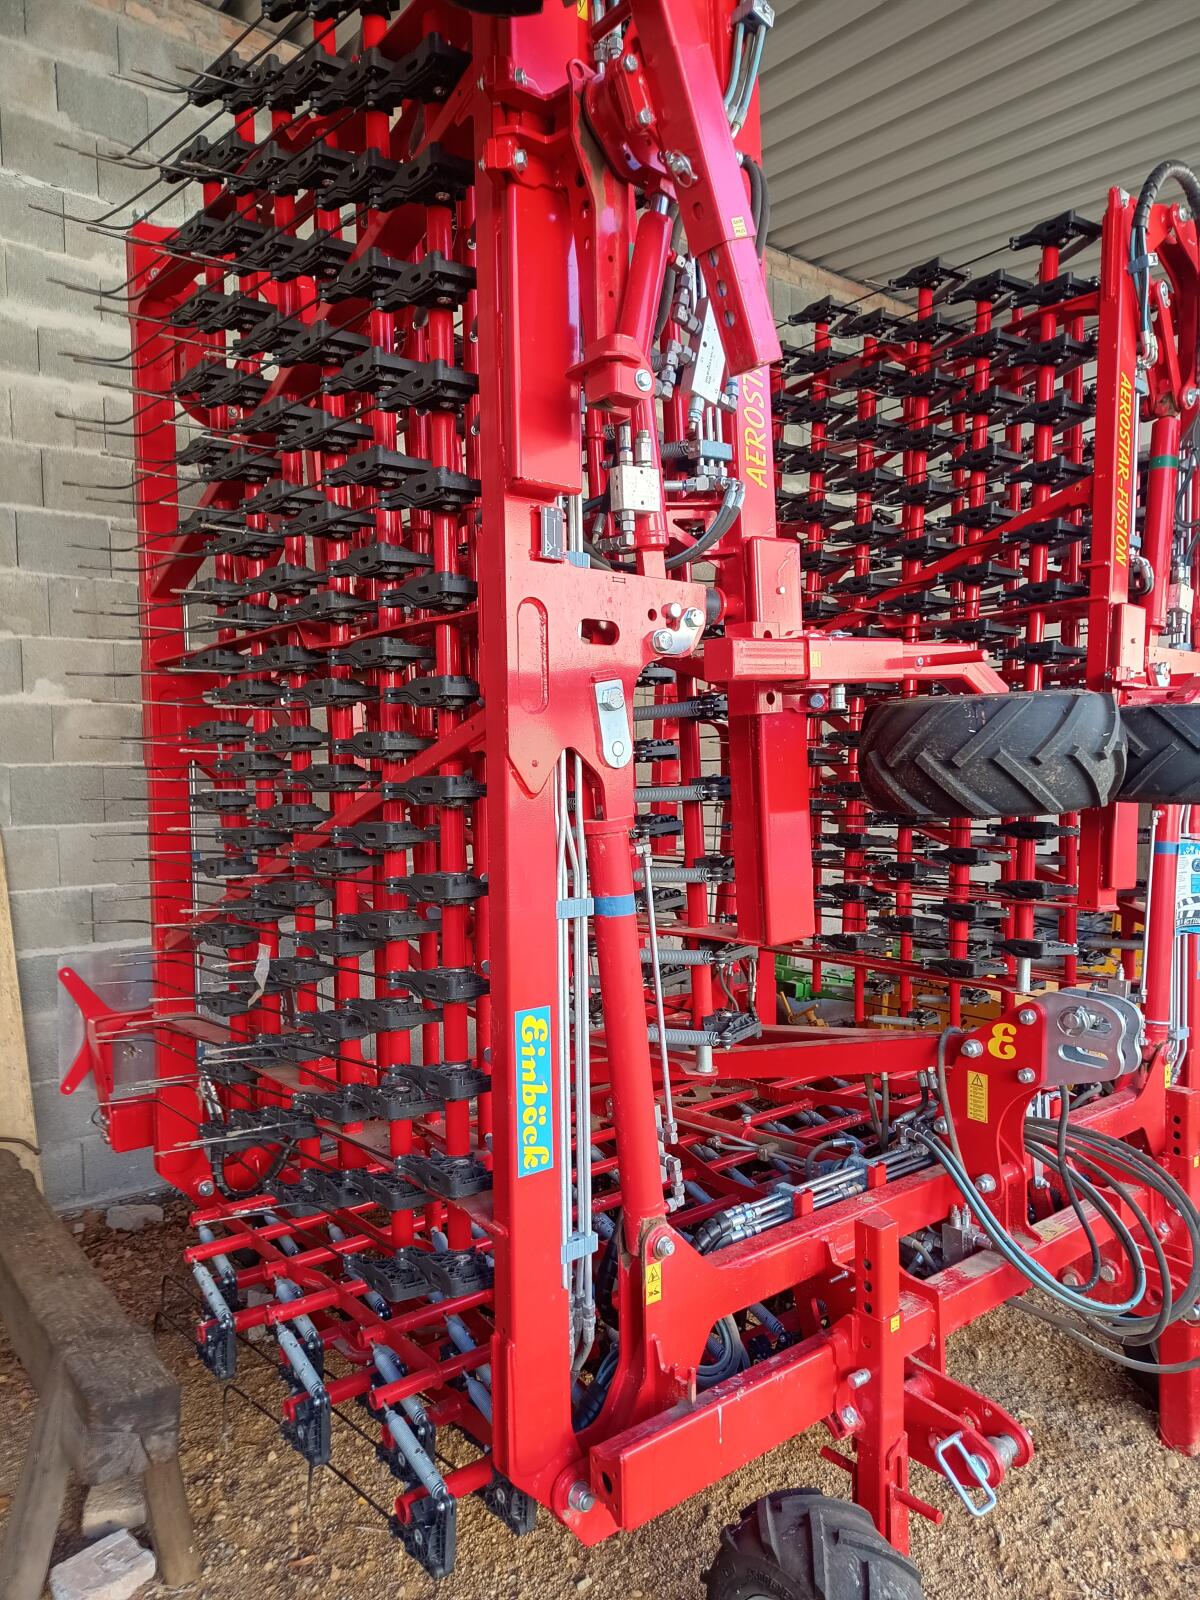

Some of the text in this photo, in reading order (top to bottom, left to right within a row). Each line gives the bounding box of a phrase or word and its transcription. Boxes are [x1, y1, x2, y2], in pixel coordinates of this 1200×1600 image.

[742, 367, 768, 489] AEROST
[1115, 371, 1133, 567] AEROSTAR-FUSION
[521, 1014, 550, 1170] Einböck
